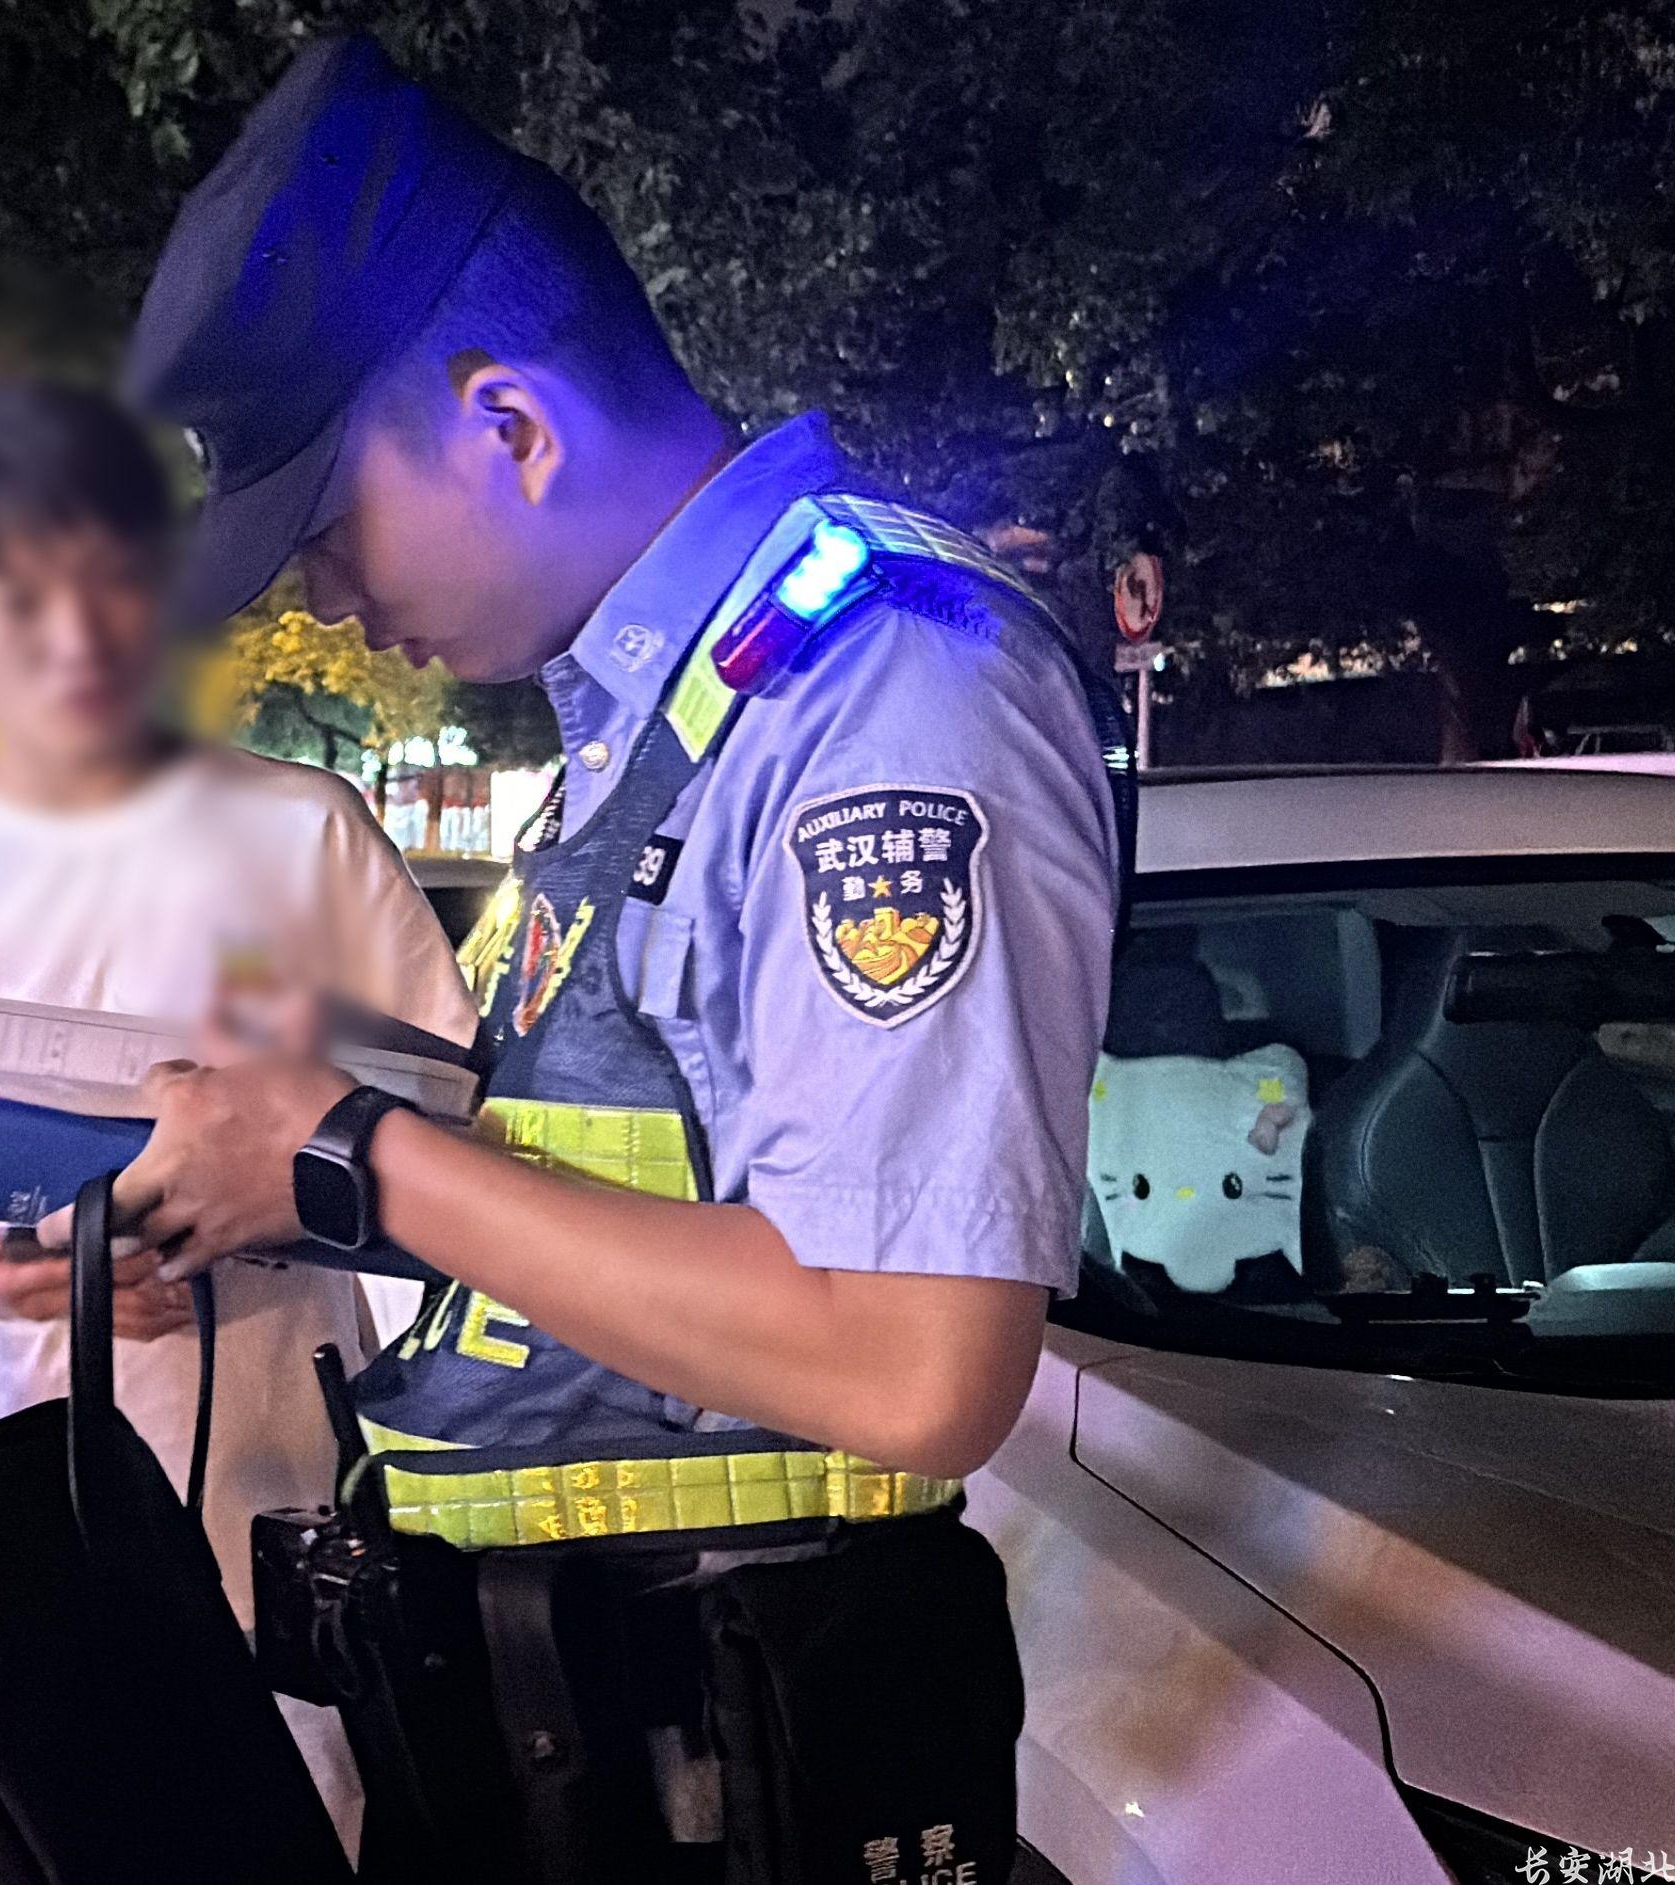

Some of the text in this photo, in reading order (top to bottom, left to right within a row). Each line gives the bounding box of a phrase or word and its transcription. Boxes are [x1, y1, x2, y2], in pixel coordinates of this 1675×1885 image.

[798, 800, 970, 843] AUXILIARY POLICE
[815, 827, 952, 873] 武汉辅警
[842, 870, 924, 901] 勤务
[864, 1823, 956, 1884] 警察
